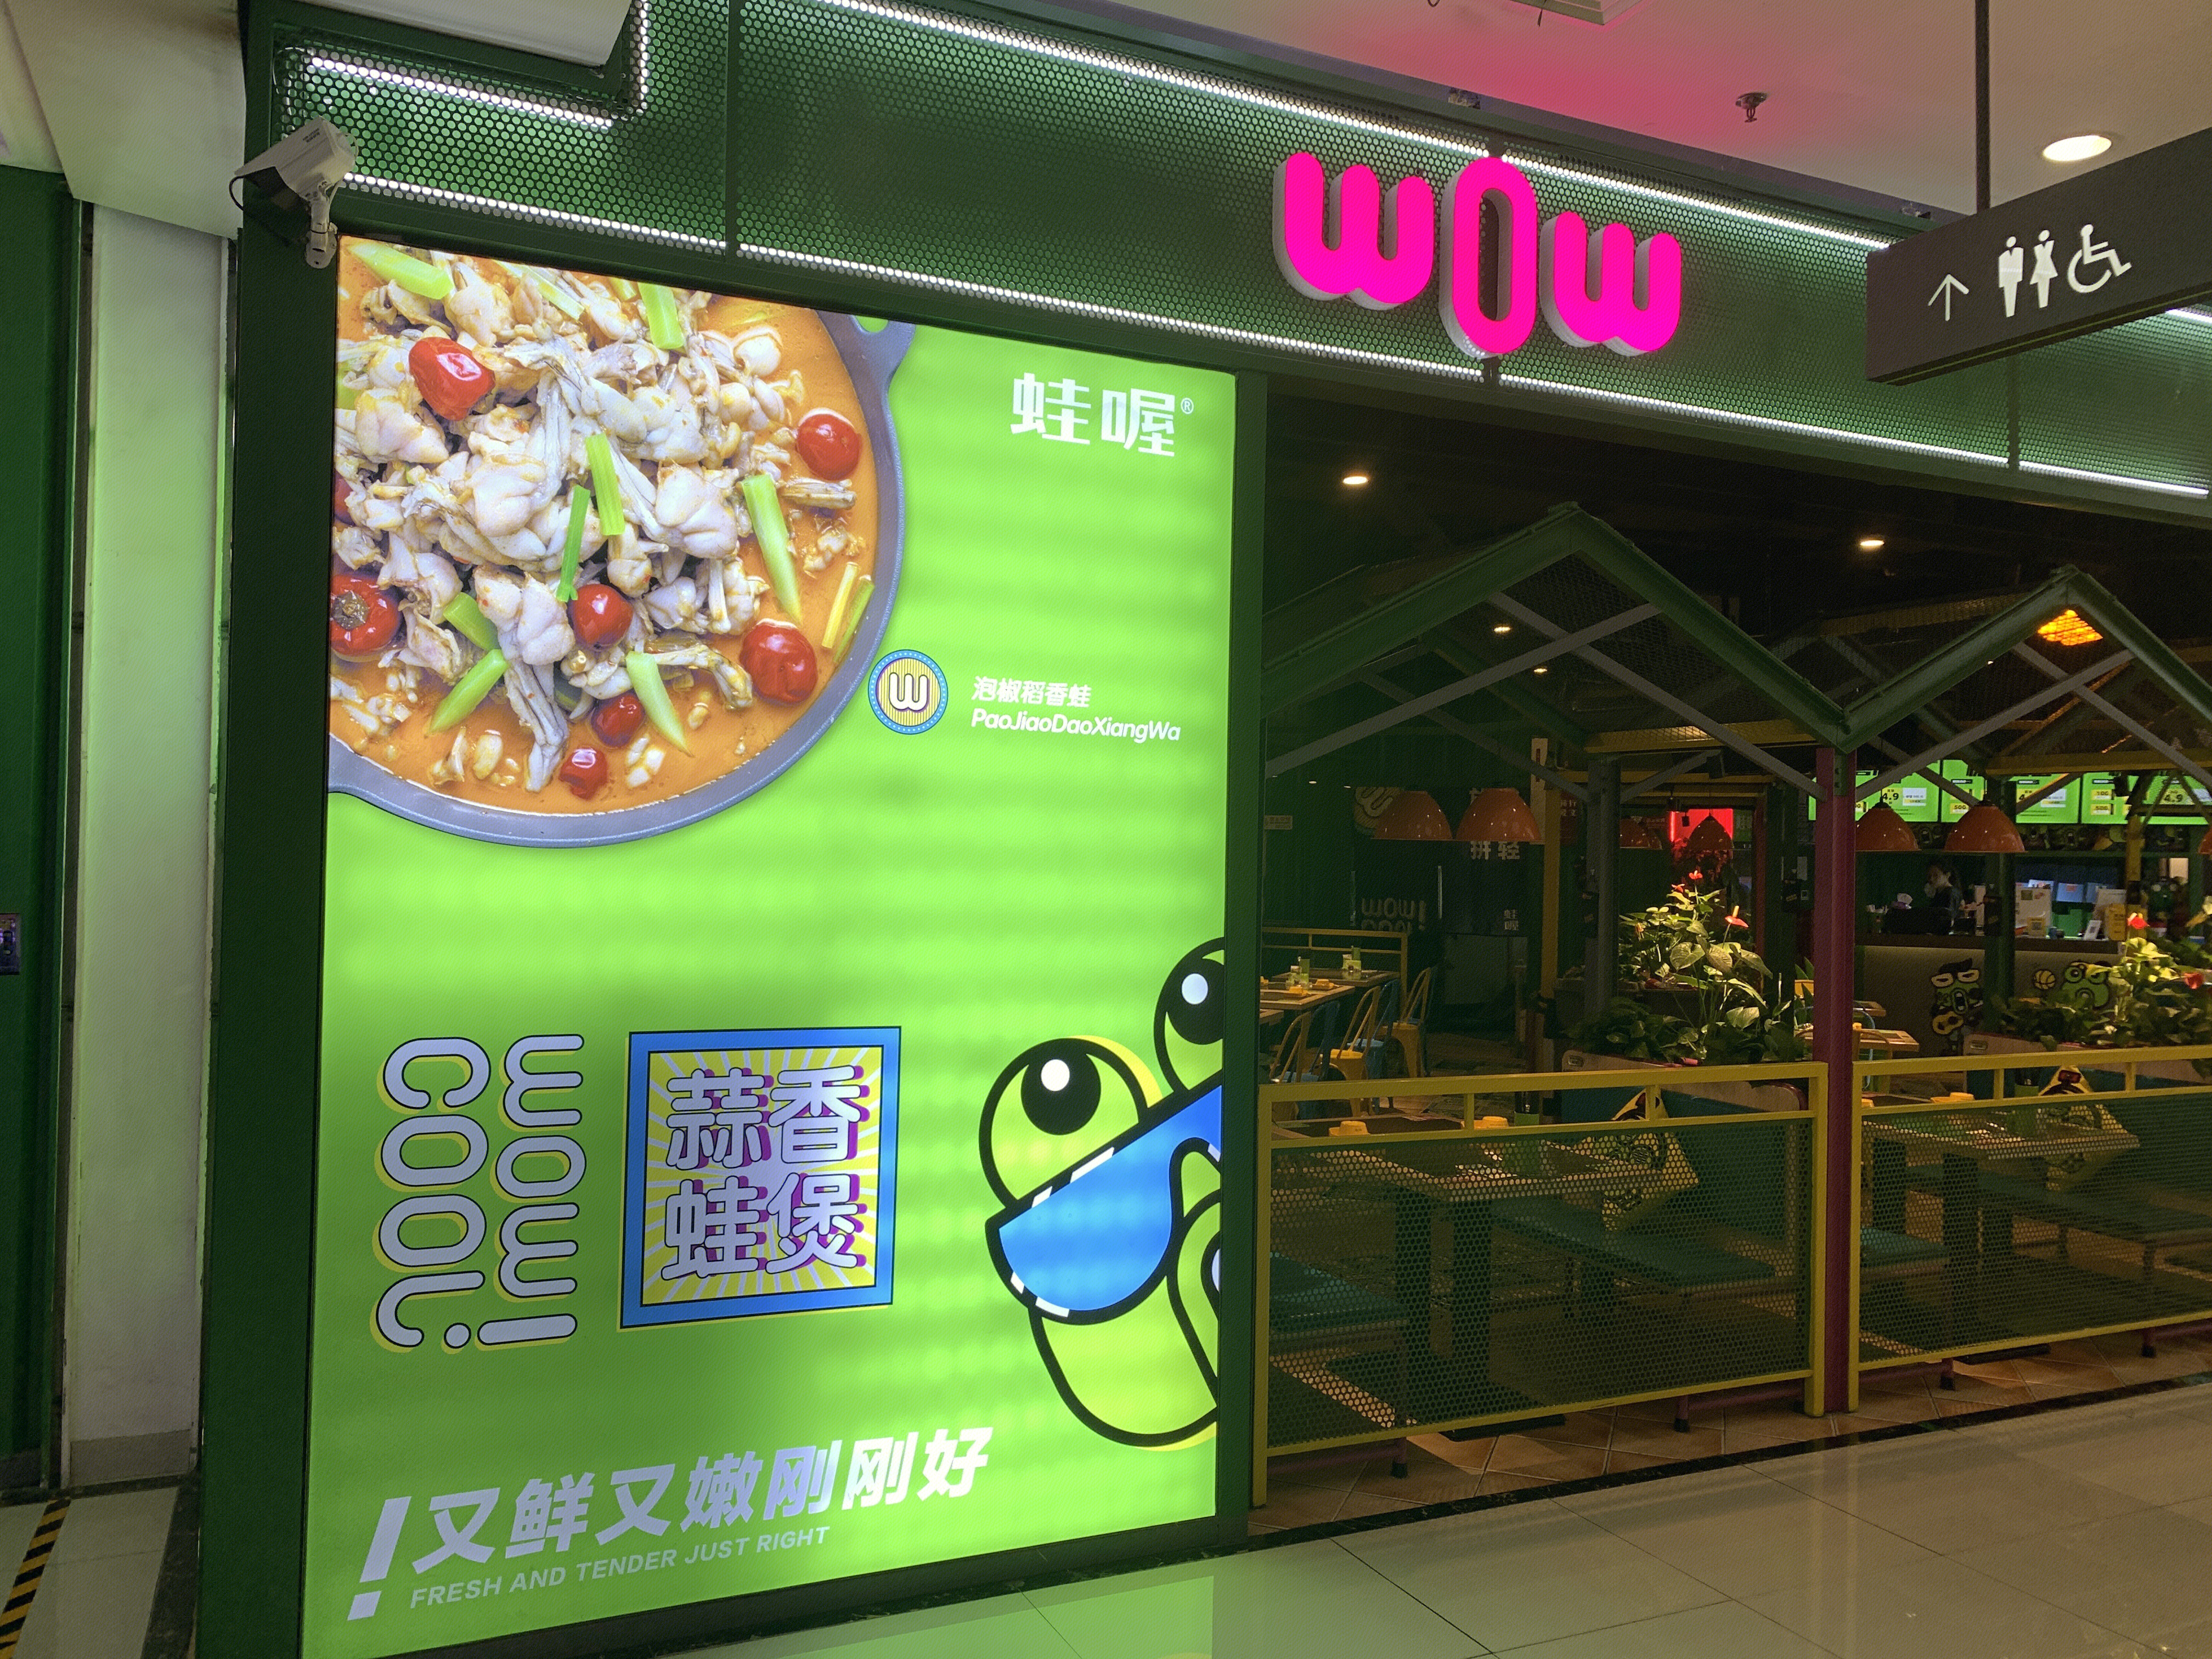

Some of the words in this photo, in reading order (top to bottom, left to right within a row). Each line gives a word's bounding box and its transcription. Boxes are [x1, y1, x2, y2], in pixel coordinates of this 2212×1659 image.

[1011, 373, 1175, 456] 蛙喔
[971, 675, 1092, 708] 泡椒稻香蛙
[971, 708, 1181, 744] PaoJiaoDaoXiangWa
[410, 1576, 502, 1609] FRESH
[509, 1567, 567, 1593] AND
[577, 1549, 678, 1582] TENDER
[685, 1537, 750, 1564] JUST
[757, 1526, 830, 1553] RIGHT
